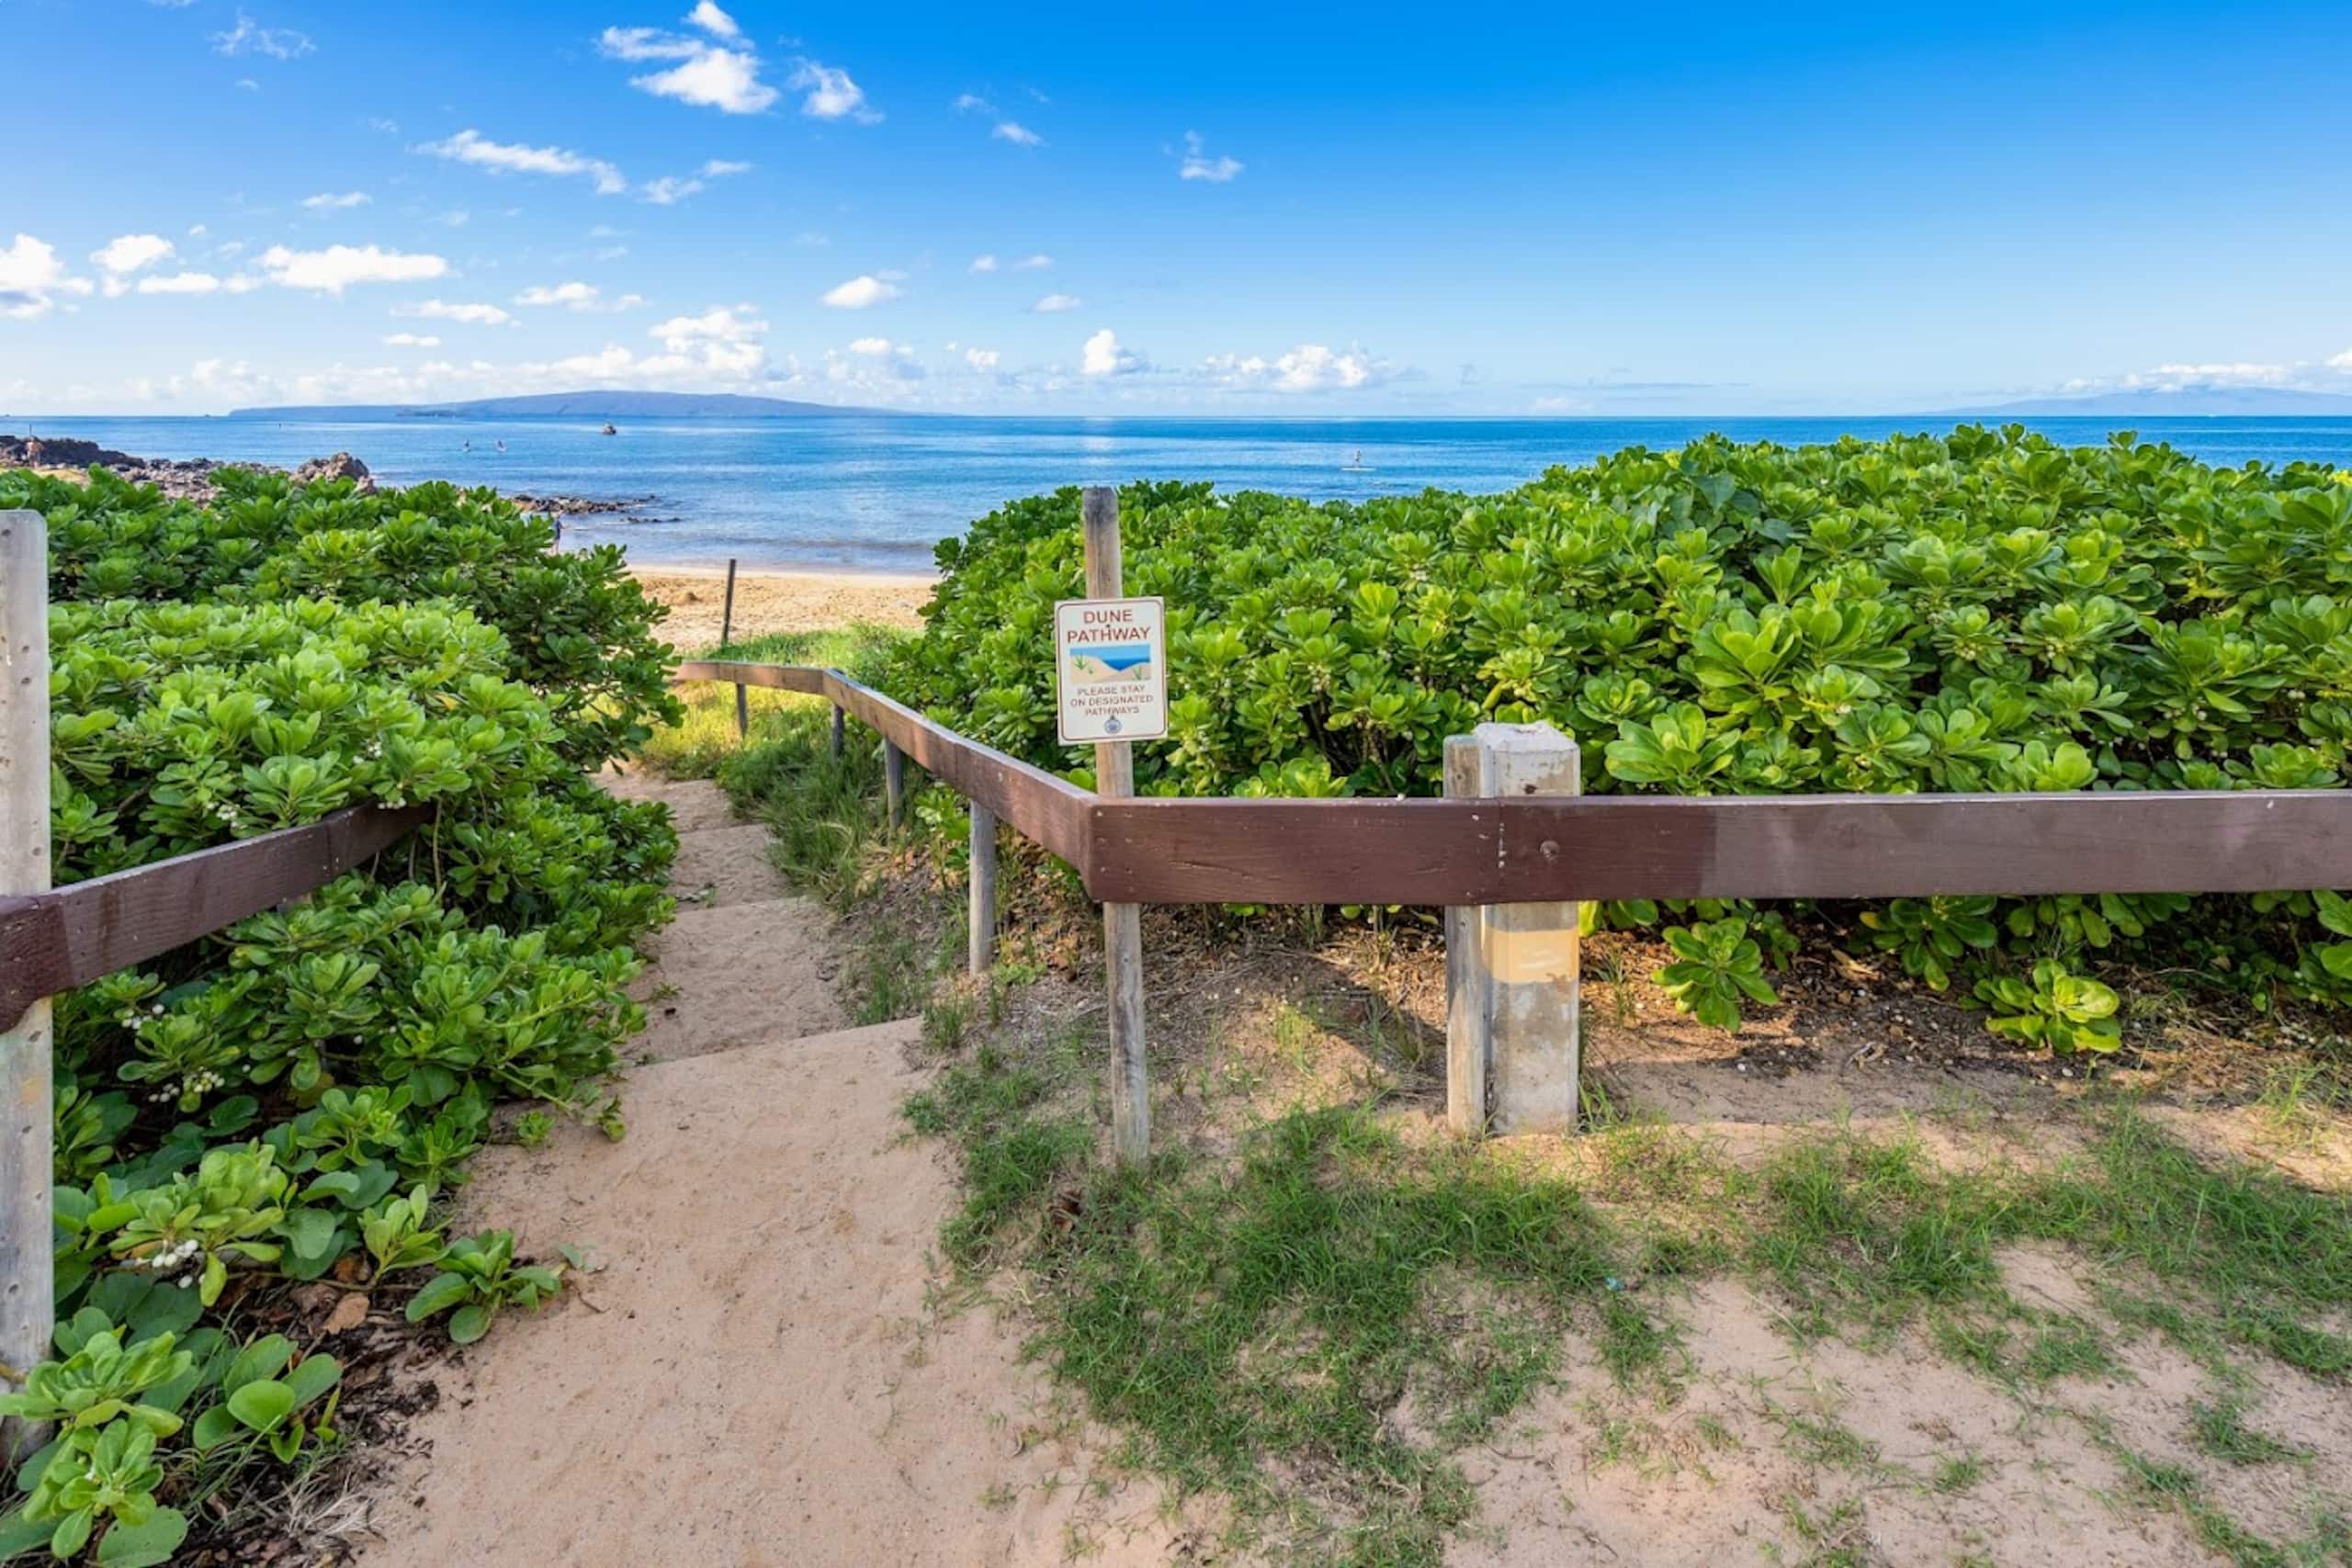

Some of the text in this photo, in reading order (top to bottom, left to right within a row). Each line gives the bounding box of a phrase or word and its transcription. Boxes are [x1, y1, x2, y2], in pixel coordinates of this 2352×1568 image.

[1083, 609, 1133, 624] DUNE
[1067, 626, 1151, 643] PATHWAY
[1077, 684, 1146, 696] PLEASE STAY
[1069, 694, 1154, 707] ON DESIGNATED
[1085, 706, 1140, 716] PATHWAYS
